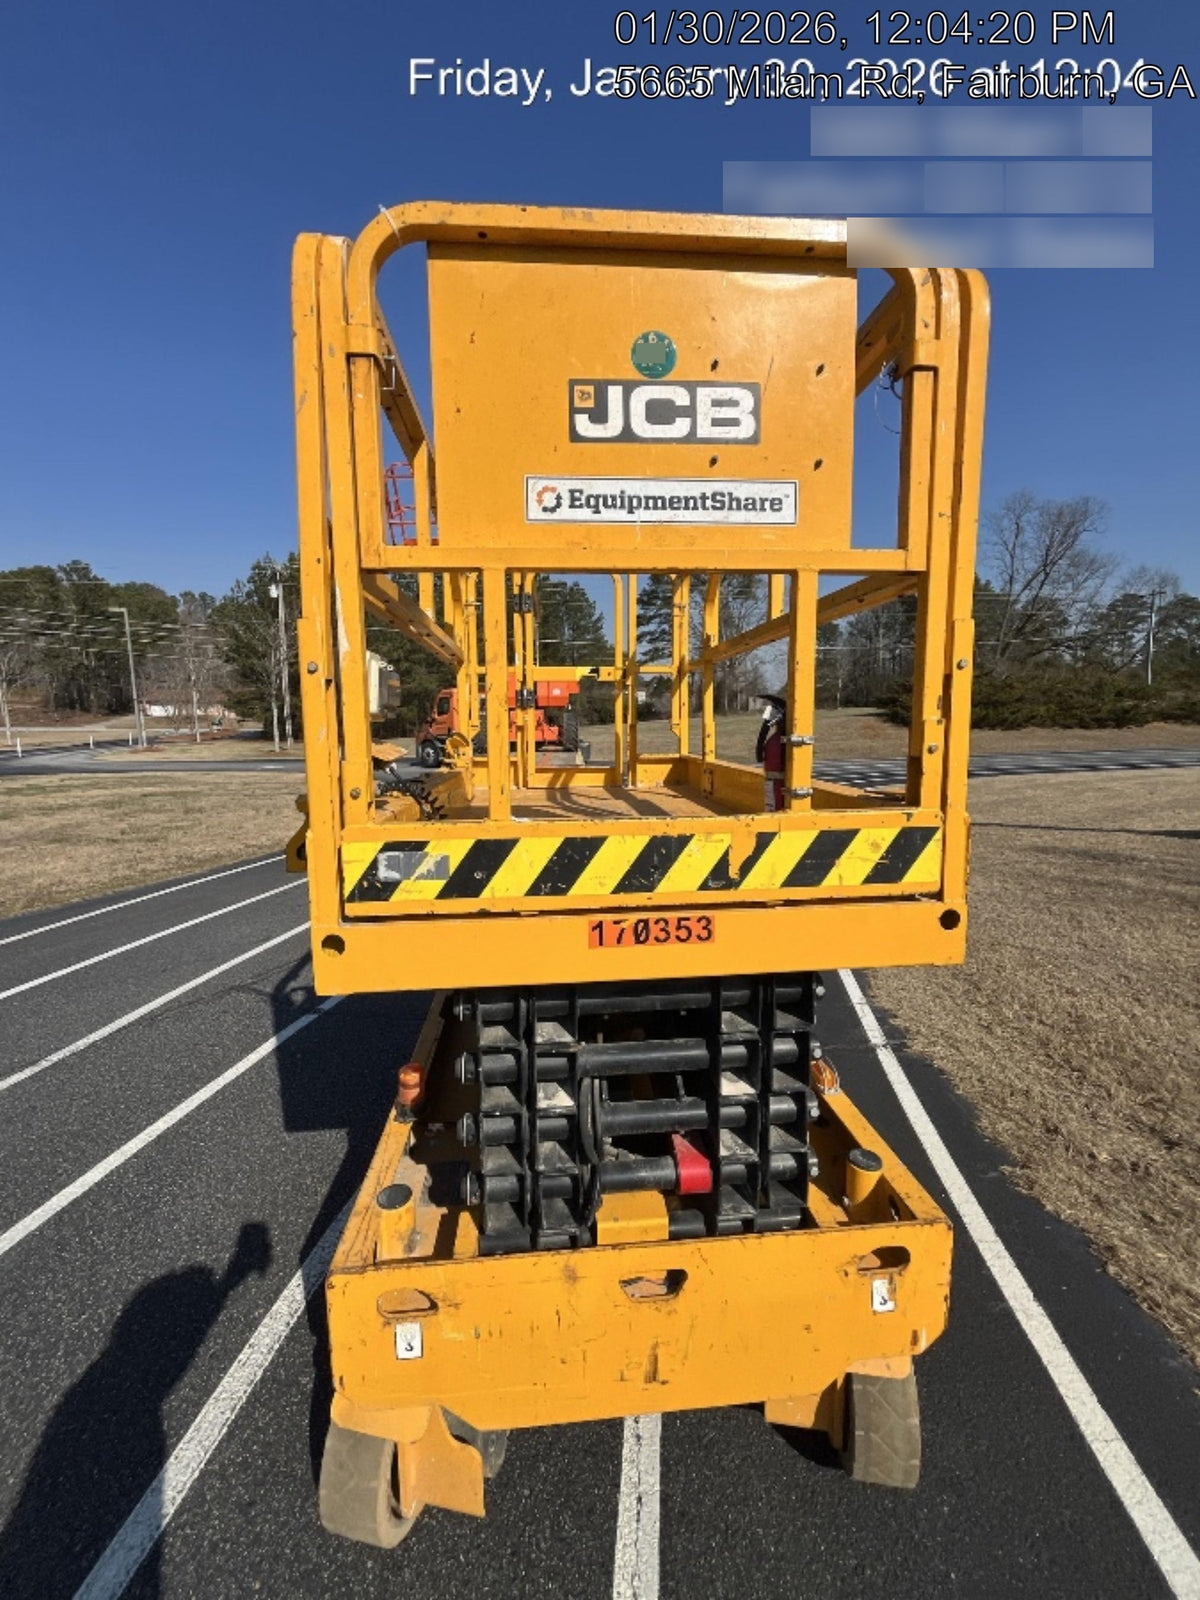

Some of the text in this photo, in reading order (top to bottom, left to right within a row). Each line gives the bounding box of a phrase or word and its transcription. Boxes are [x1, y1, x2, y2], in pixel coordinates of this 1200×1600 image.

[573, 384, 757, 439] JCB
[568, 488, 783, 514] EquipmentShare
[591, 915, 713, 946] 170353
